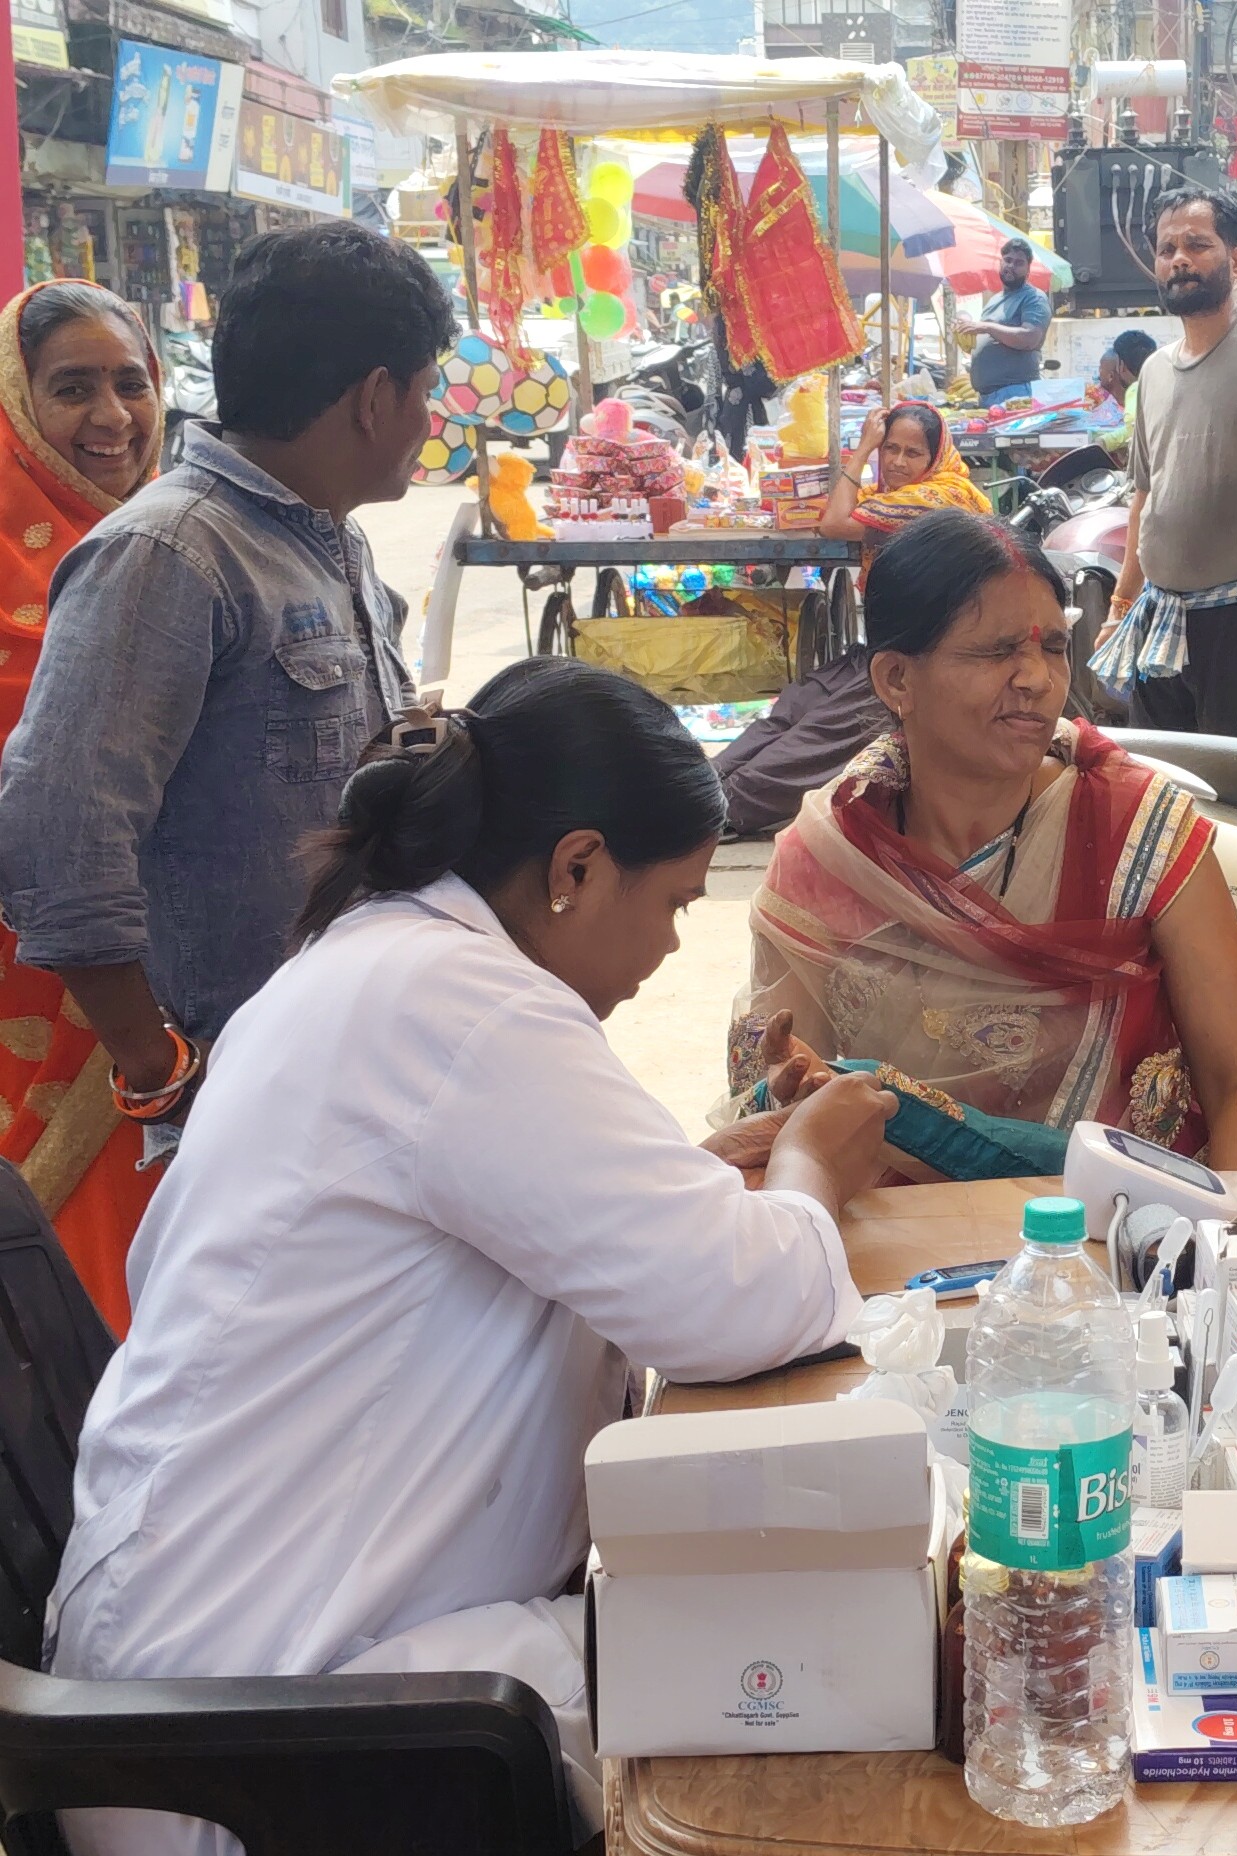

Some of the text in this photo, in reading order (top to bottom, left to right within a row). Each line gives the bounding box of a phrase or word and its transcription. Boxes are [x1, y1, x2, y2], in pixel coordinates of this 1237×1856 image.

[1096, 1524, 1121, 1540] trusted
[738, 1700, 785, 1711] CGMSC
[775, 1712, 800, 1720] Supplies
[1223, 1718, 1235, 1736] 10 mg
[1193, 1757, 1203, 1765] 10
[1208, 1757, 1237, 1765] Tablets
[1143, 1766, 1210, 1776] Hydrochloride
